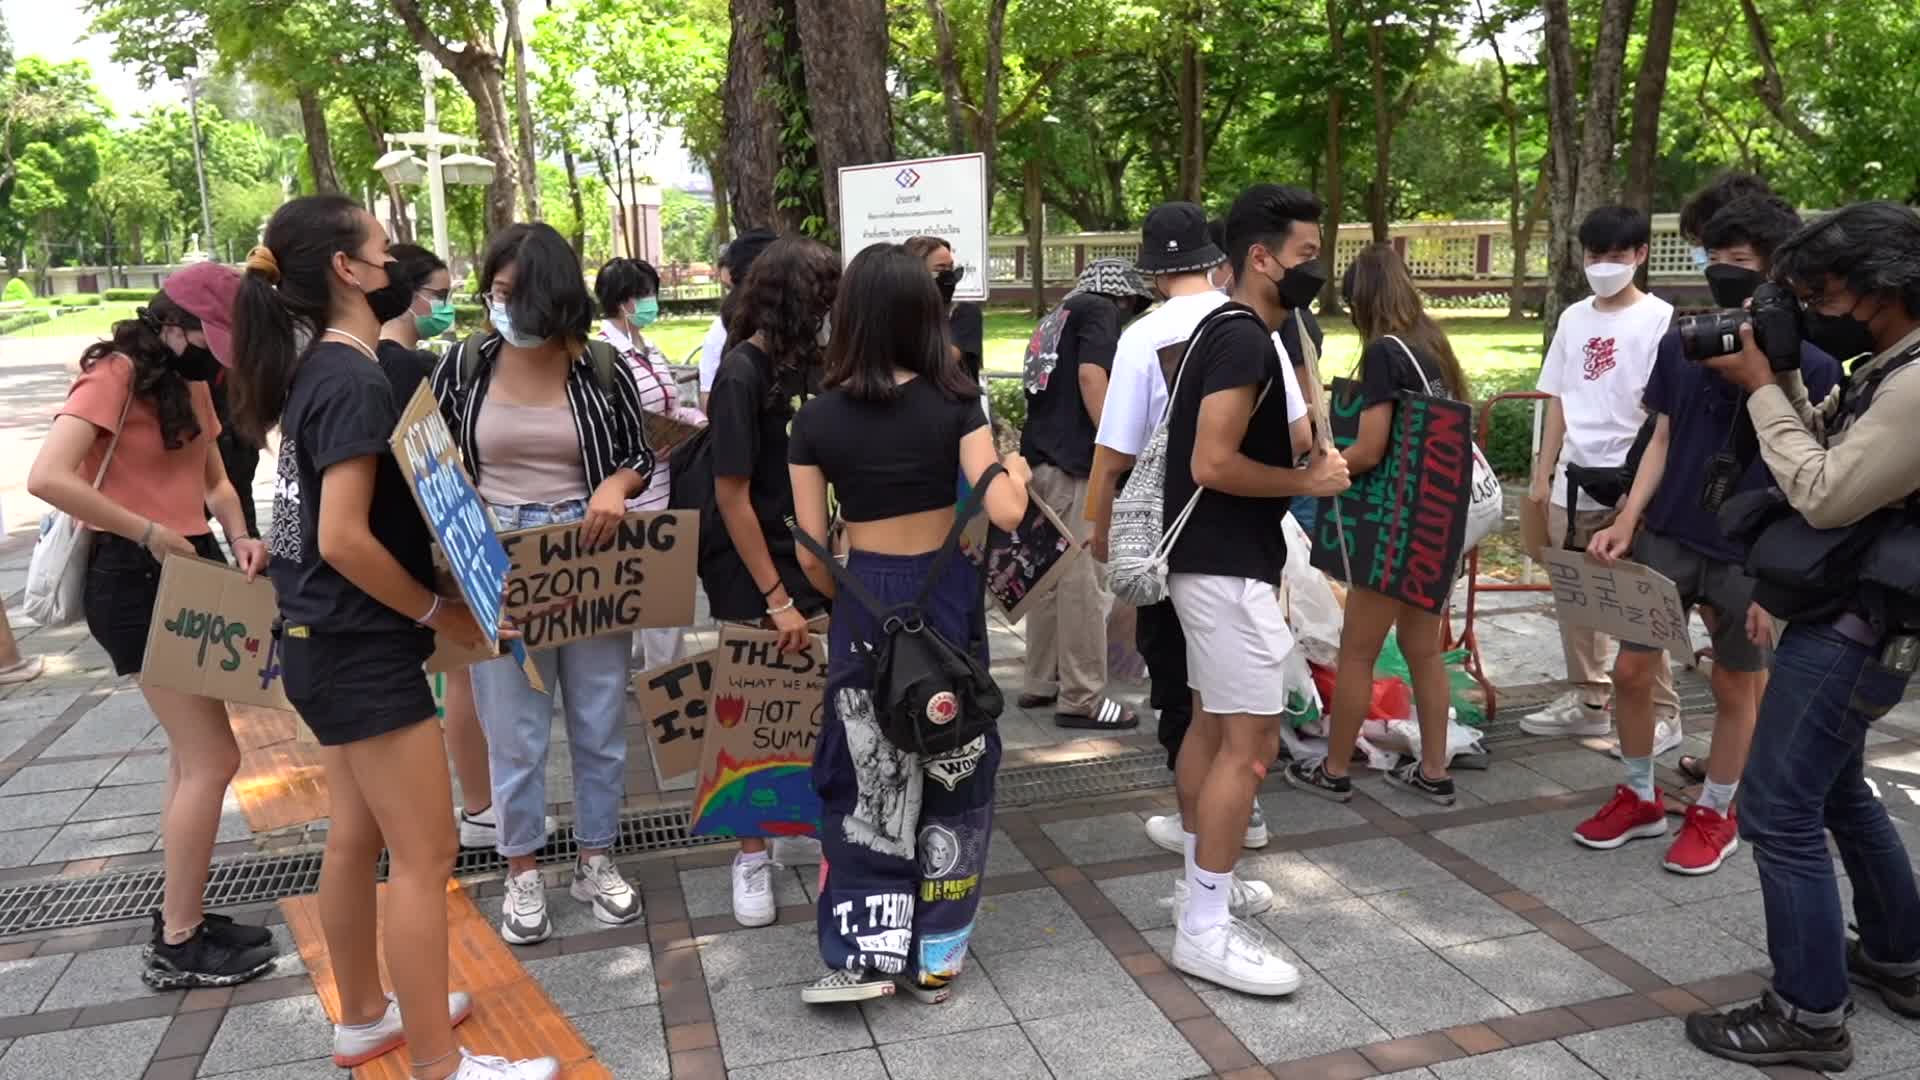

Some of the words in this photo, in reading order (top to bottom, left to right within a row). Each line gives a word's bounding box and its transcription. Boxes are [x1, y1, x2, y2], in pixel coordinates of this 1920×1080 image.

[403, 423, 429, 478] ACT
[418, 456, 465, 524] BEFORE
[1401, 405, 1465, 608] POLLUTION
[615, 558, 644, 585] IS
[1551, 562, 1586, 607] AIR
[1592, 572, 1623, 616] THE
[1625, 606, 1646, 624] IN
[165, 608, 246, 671] Solar
[518, 590, 641, 645] URNING
[725, 639, 815, 674] THIS
[729, 676, 776, 689] WHAT
[783, 680, 800, 690] WE
[744, 700, 801, 724] HOT
[833, 900, 858, 935] T.
